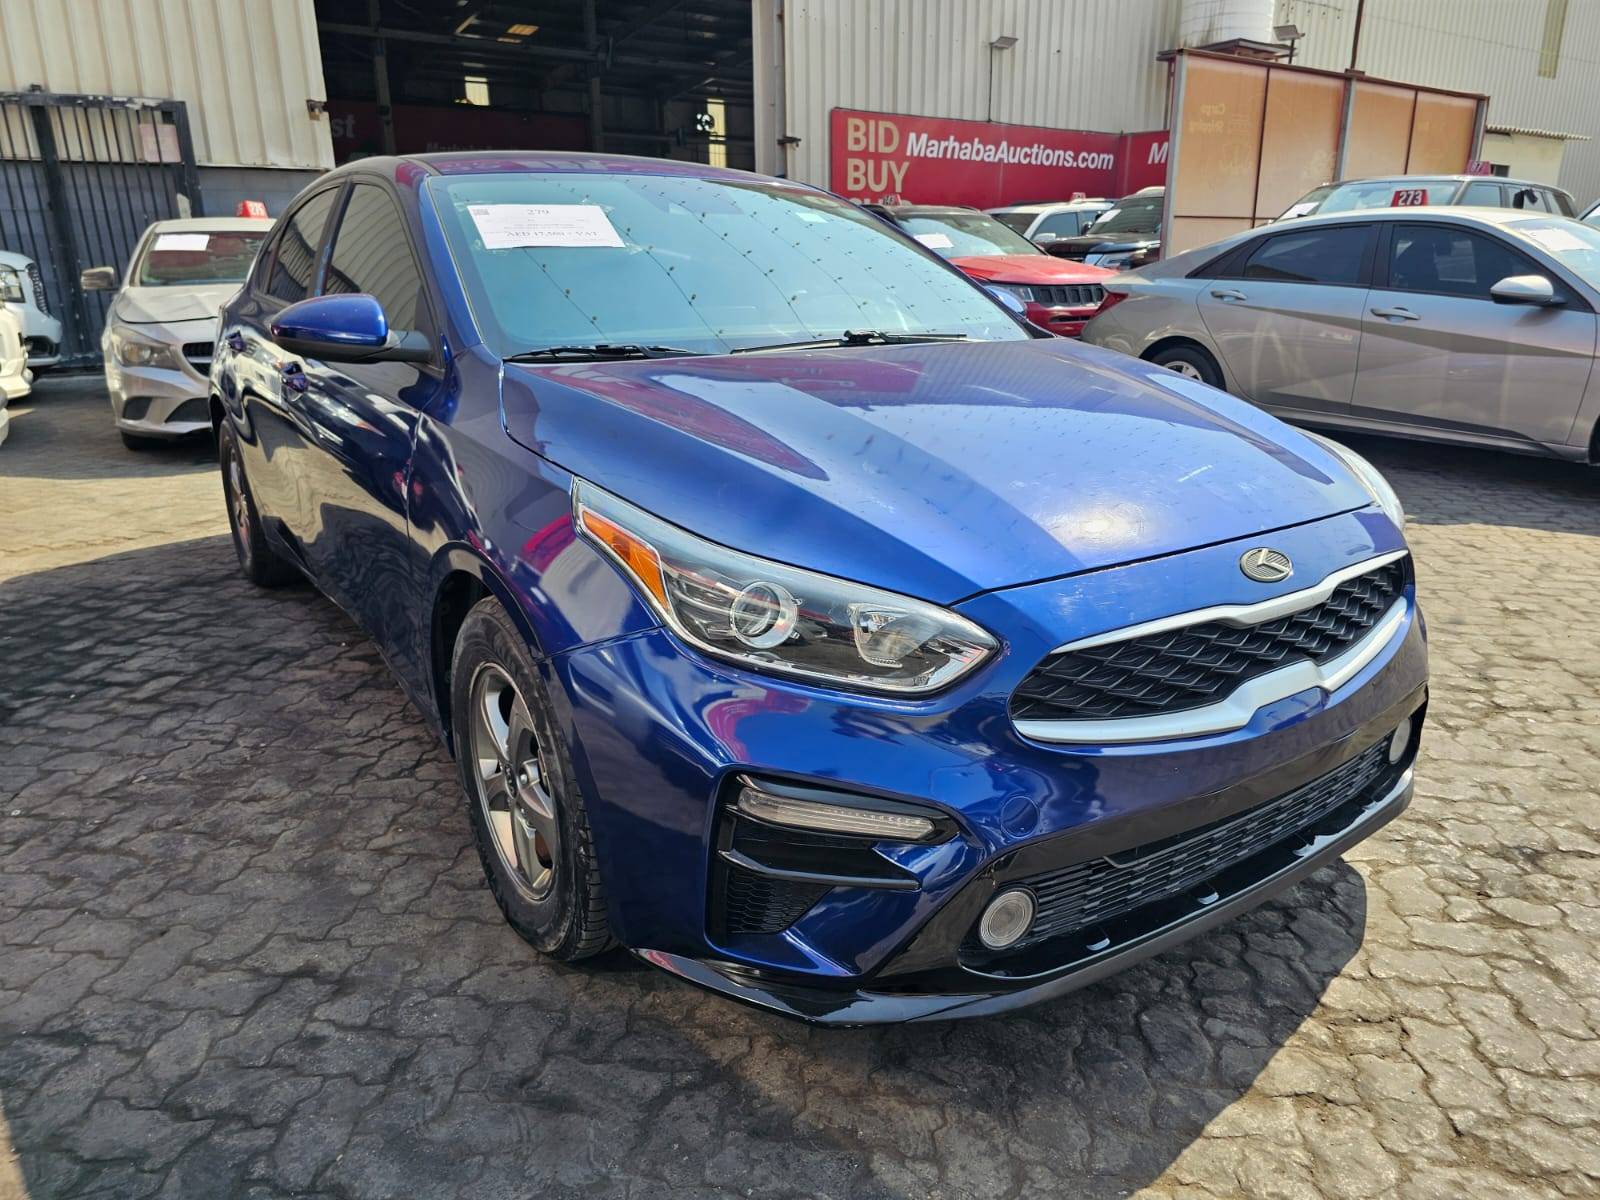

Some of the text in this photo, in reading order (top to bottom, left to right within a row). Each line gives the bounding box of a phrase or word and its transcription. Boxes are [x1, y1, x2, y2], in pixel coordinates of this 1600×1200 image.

[847, 118, 900, 154] BID
[906, 131, 1114, 170] MarhabaAuctions.com
[847, 158, 910, 193] BUY
[1398, 190, 1423, 206] 273
